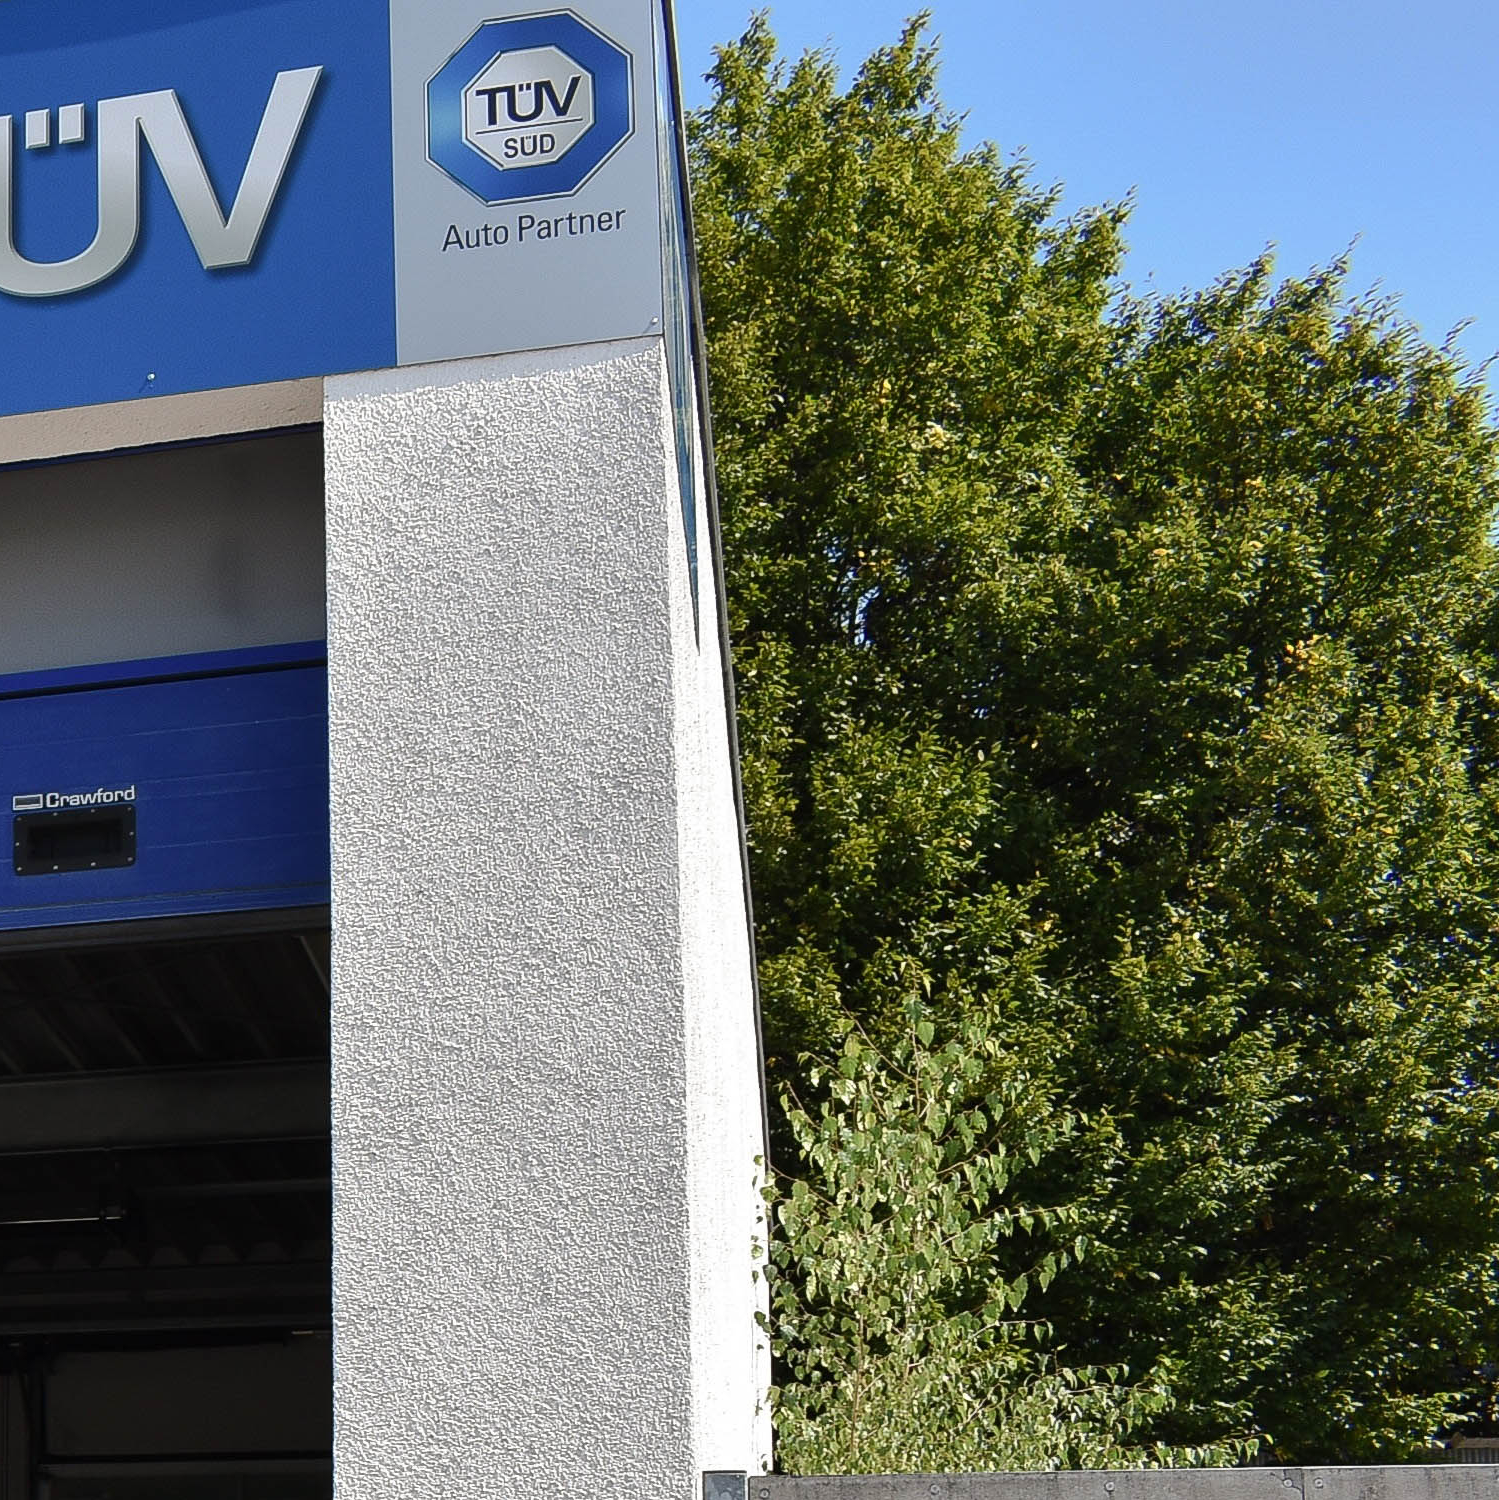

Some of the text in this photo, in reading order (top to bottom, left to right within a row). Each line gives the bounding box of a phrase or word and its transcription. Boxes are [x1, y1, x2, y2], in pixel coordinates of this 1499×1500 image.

[475, 75, 582, 126] TÜV
[503, 133, 556, 159] SÜD
[442, 208, 626, 252] Auto Partner
[46, 784, 136, 808] Crawford
